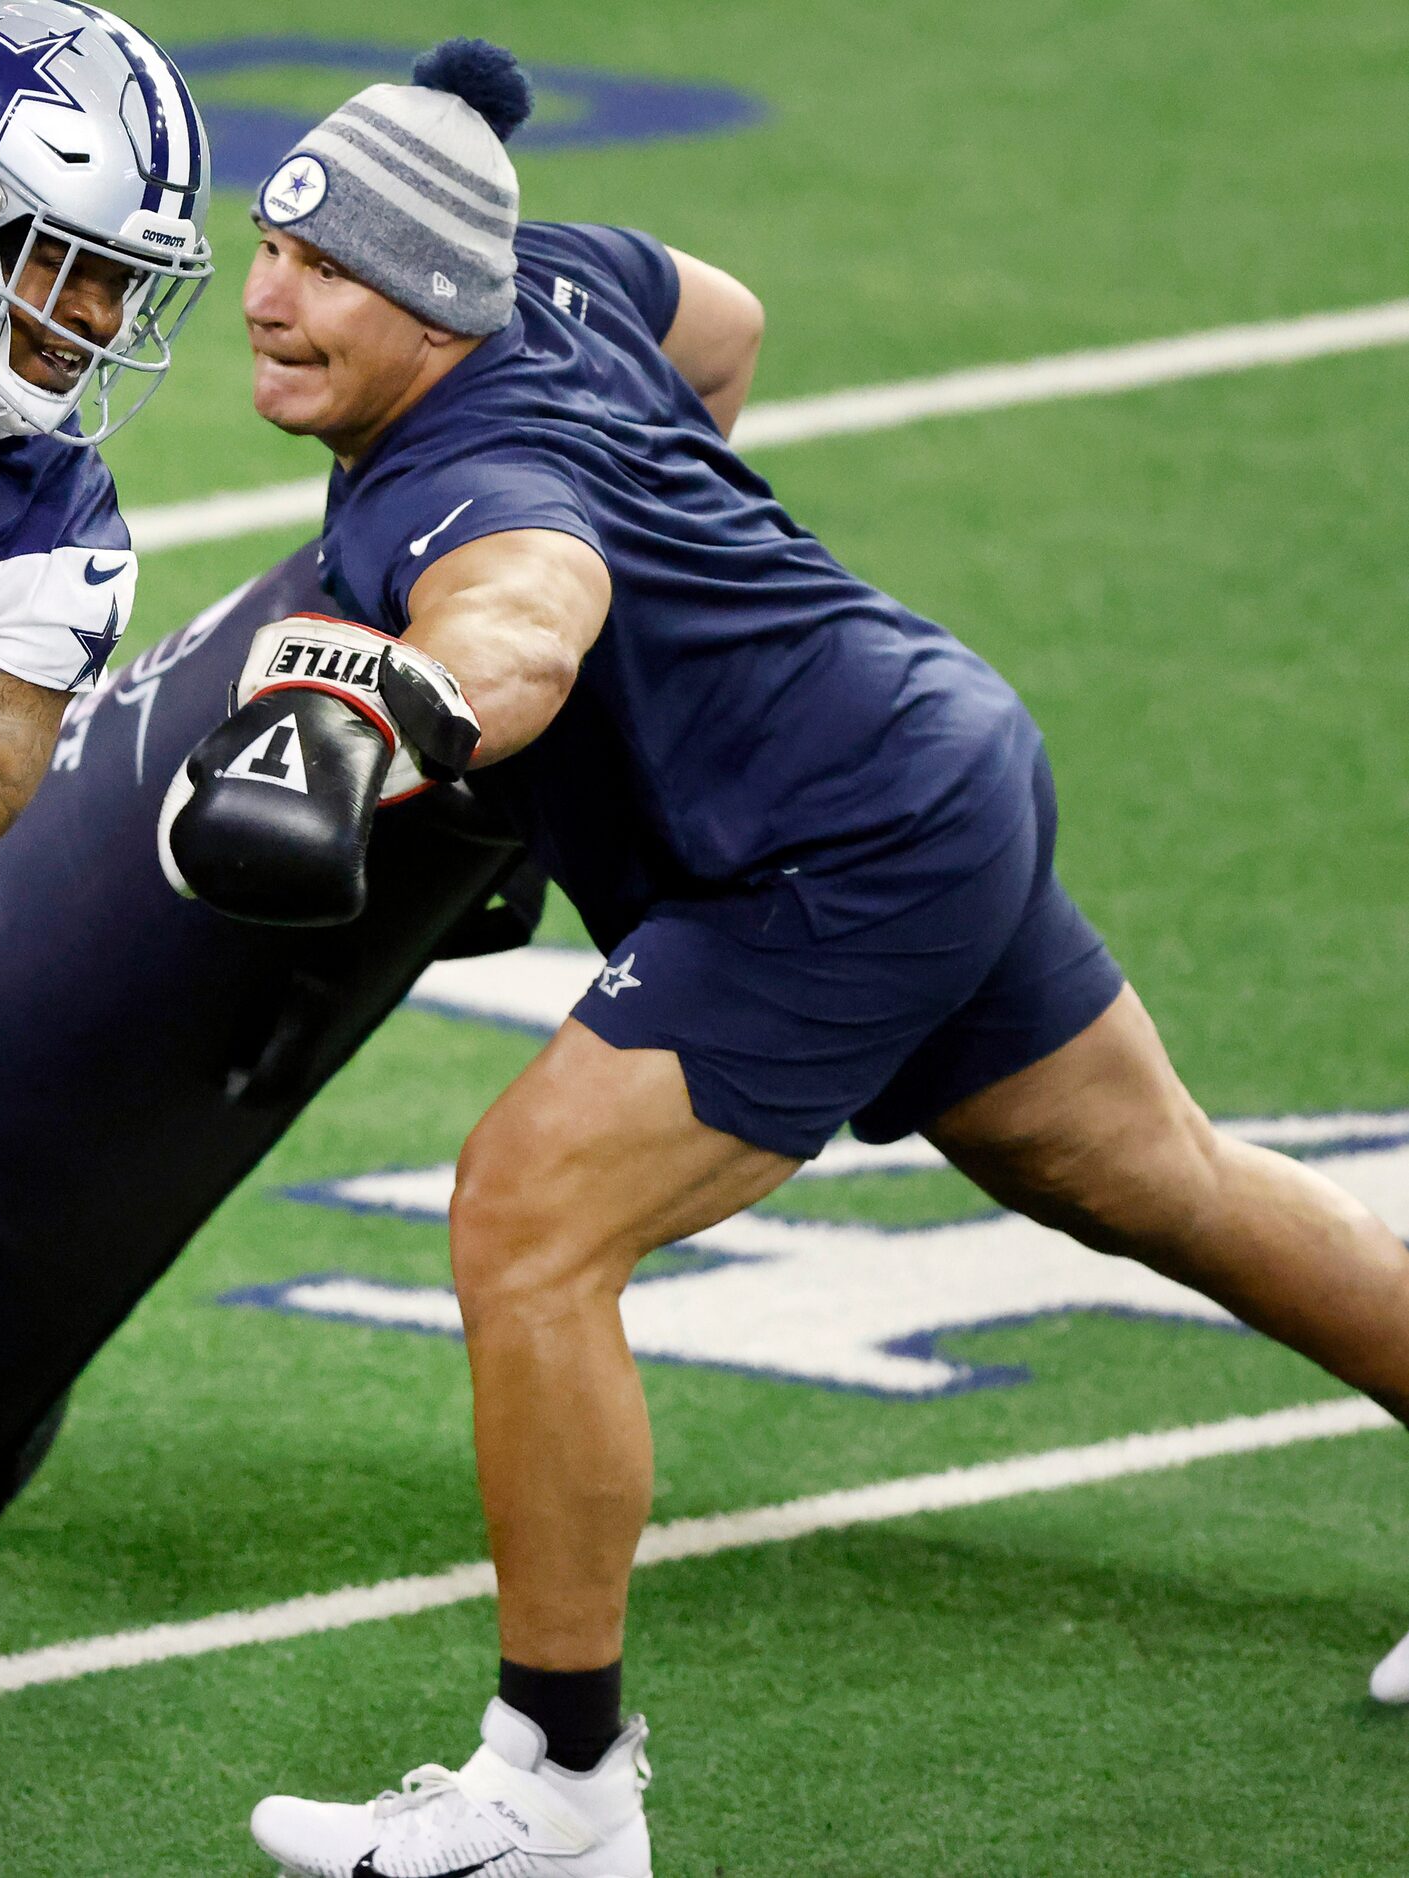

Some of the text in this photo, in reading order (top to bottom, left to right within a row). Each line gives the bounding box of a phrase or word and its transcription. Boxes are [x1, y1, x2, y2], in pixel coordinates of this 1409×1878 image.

[142, 229, 186, 248] COWBOYS
[275, 644, 379, 687] TITLE
[248, 725, 295, 779] T
[489, 1800, 530, 1837] ALPHA
